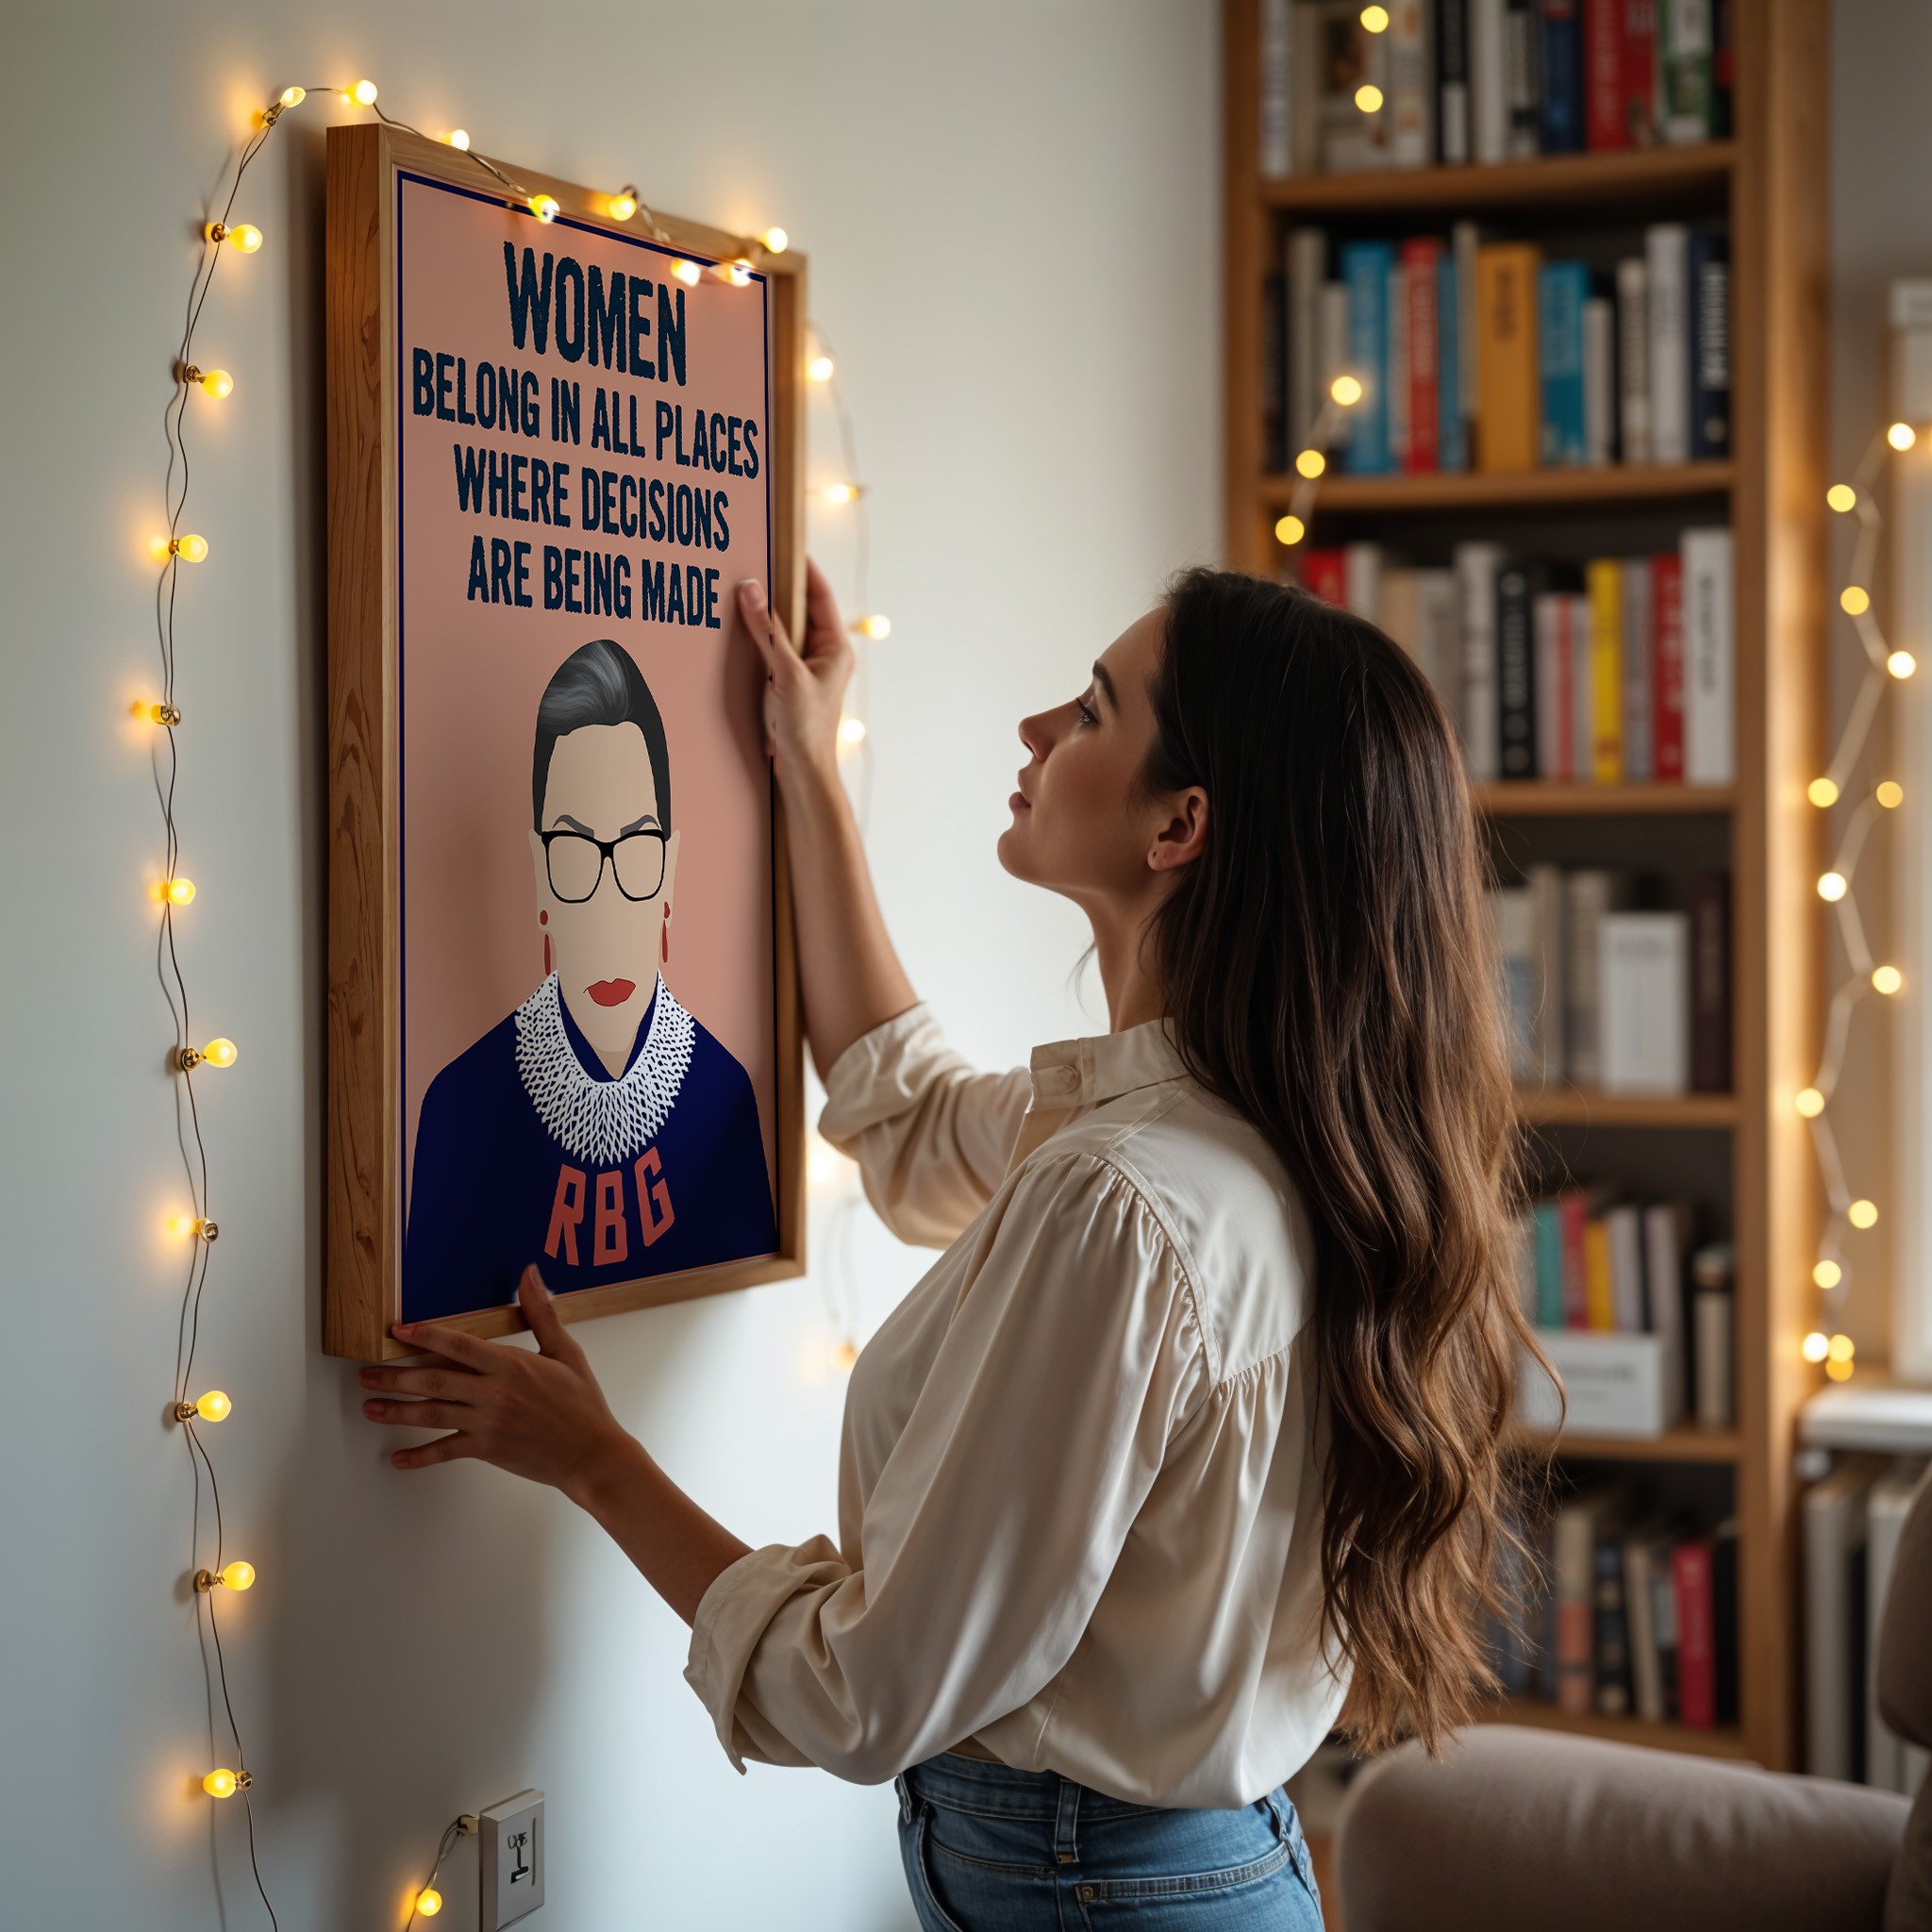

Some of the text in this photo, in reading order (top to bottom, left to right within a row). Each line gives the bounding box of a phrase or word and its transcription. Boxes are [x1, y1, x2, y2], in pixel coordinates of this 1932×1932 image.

[504, 241, 687, 387] WOMEN
[412, 347, 759, 480] BELONG IN ALL PLACES
[453, 443, 730, 553] WHERE DECISIONS
[467, 535, 721, 630] ARE BEING MADE
[543, 1145, 675, 1267] RBG
